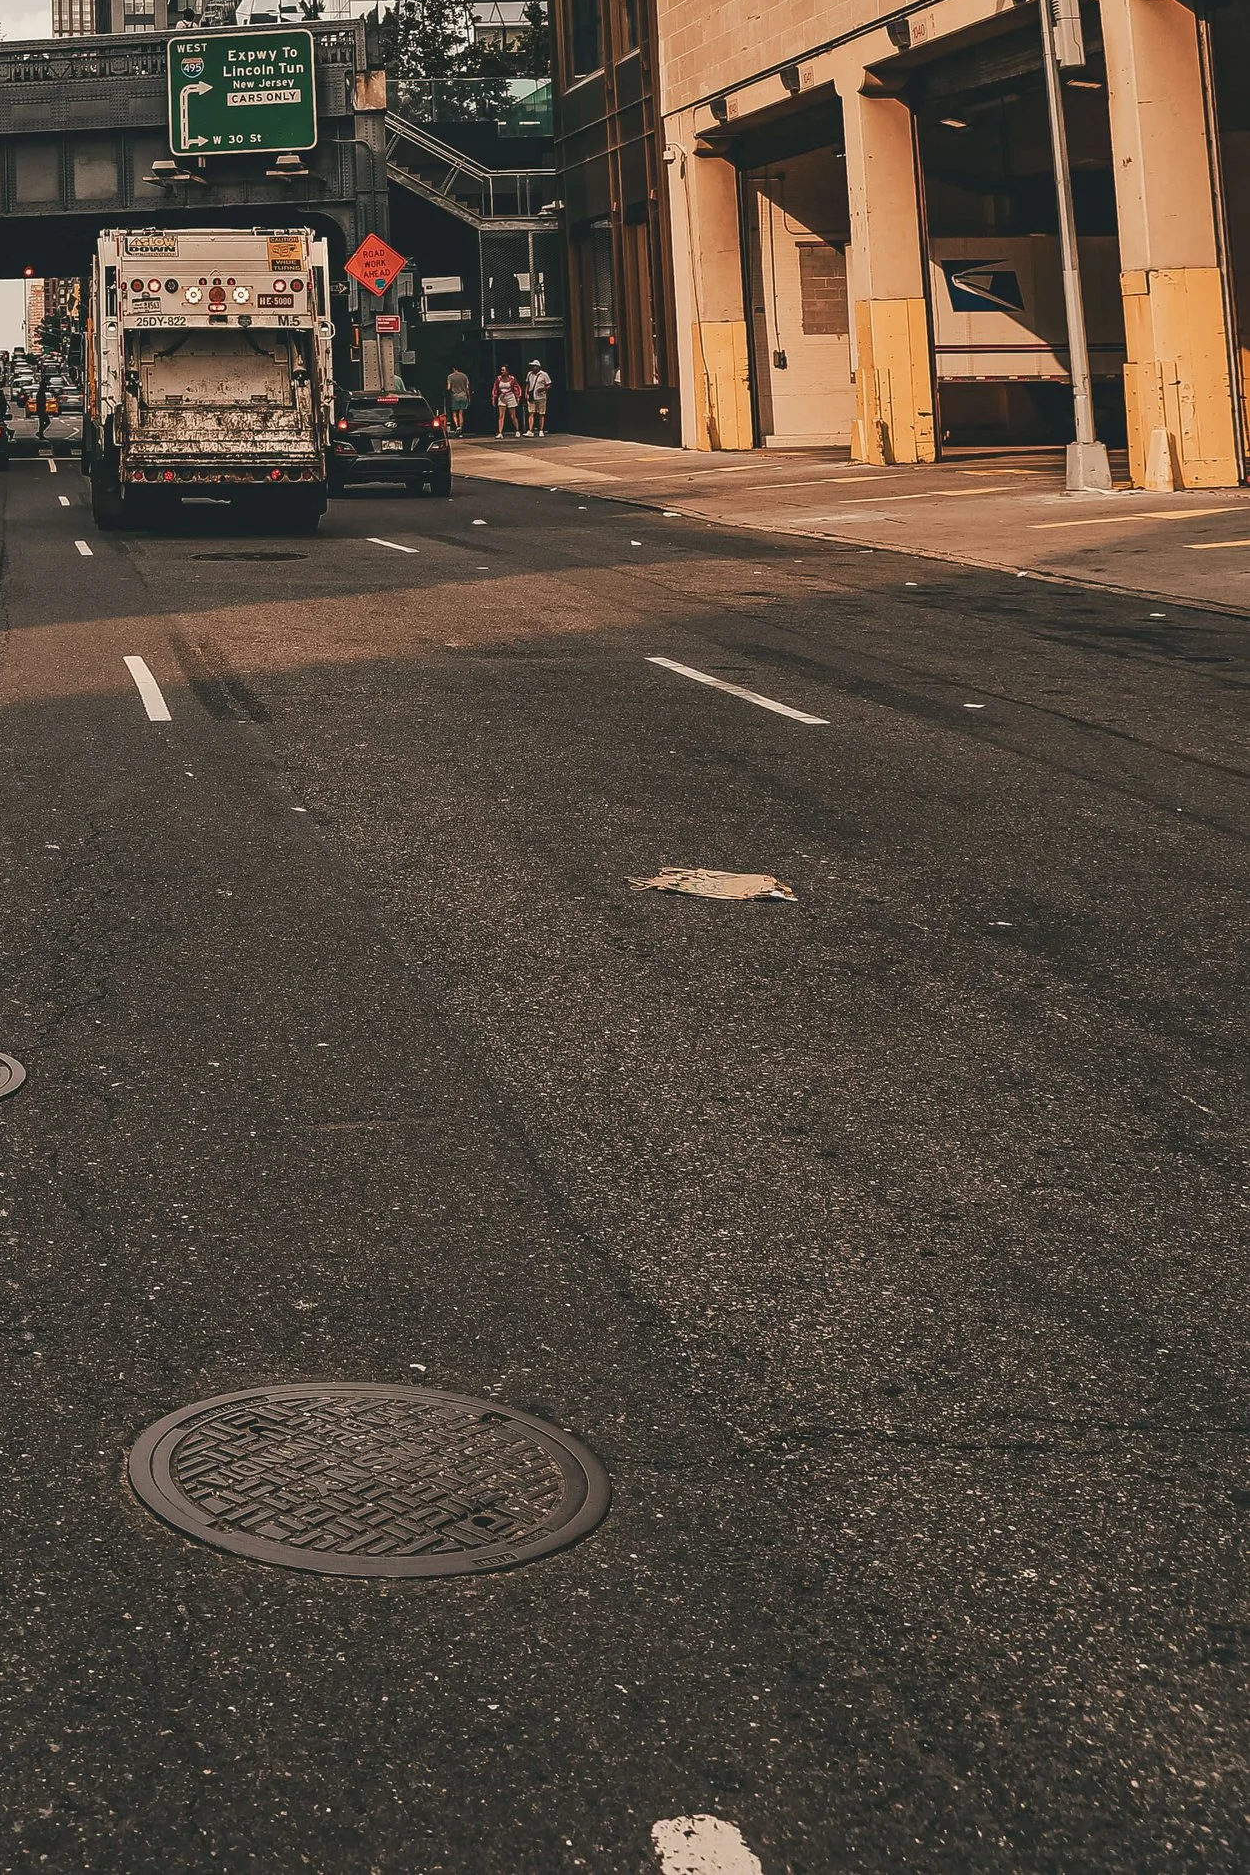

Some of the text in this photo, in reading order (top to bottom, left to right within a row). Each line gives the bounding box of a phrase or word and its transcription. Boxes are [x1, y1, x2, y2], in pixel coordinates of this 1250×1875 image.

[912, 22, 925, 39] 1040
[177, 43, 207, 53] WEST
[228, 47, 297, 62] Expwy To
[183, 63, 202, 73] 495
[223, 63, 304, 77] Lincoln Tun
[233, 78, 294, 89] New Jersey
[231, 91, 296, 104] CARS ONLY
[213, 134, 262, 144] W 30 St
[141, 237, 175, 246] SLOW
[363, 250, 385, 258] ROAD
[365, 259, 387, 268] WORK
[363, 269, 390, 278] AHEAD
[259, 297, 292, 305] HE-5000
[136, 316, 187, 327] 25DY-822
